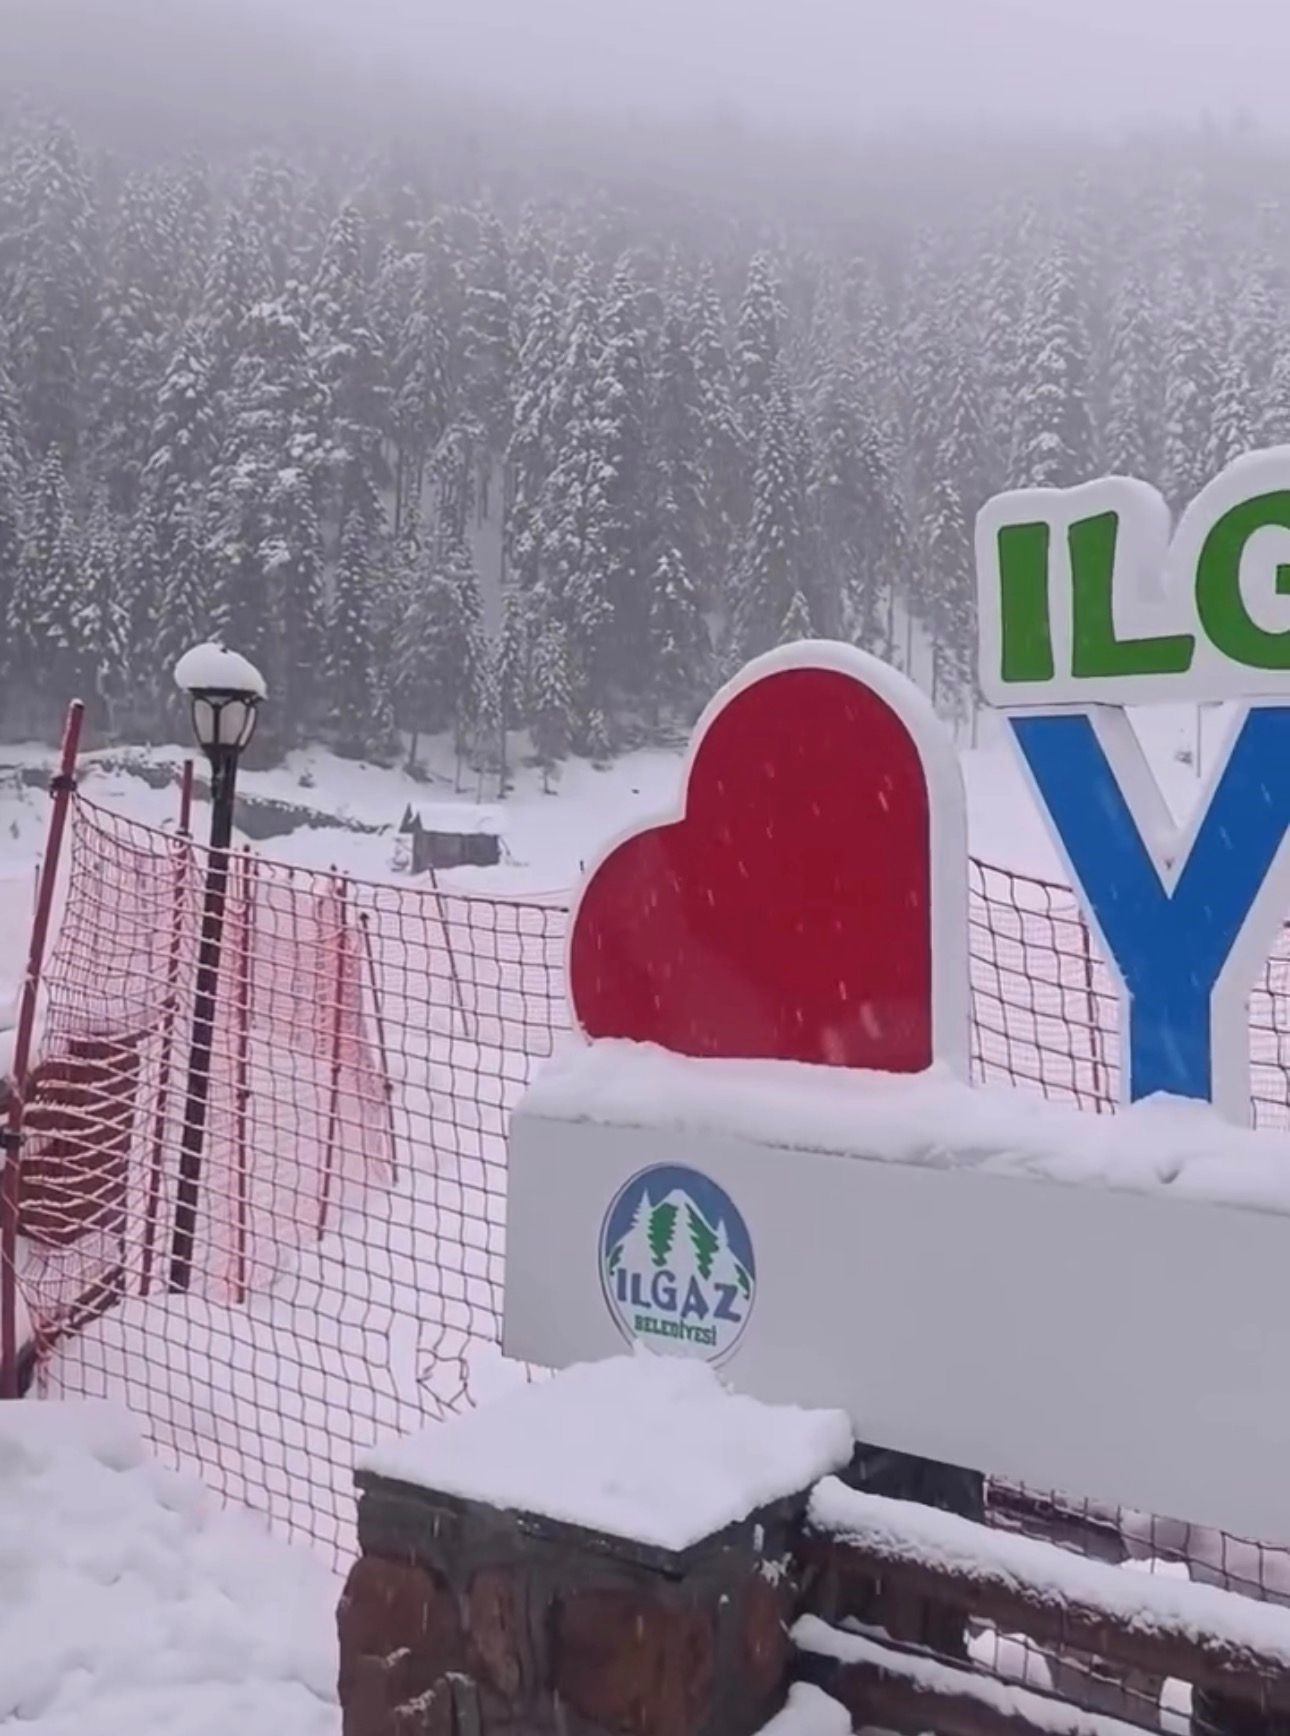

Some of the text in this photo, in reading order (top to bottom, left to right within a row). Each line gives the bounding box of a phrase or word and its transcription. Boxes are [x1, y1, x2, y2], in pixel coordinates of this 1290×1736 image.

[1008, 707, 1290, 1104] Y
[617, 1268, 742, 1322] ILGAZ
[634, 1314, 717, 1346] BELEDİYESİ
